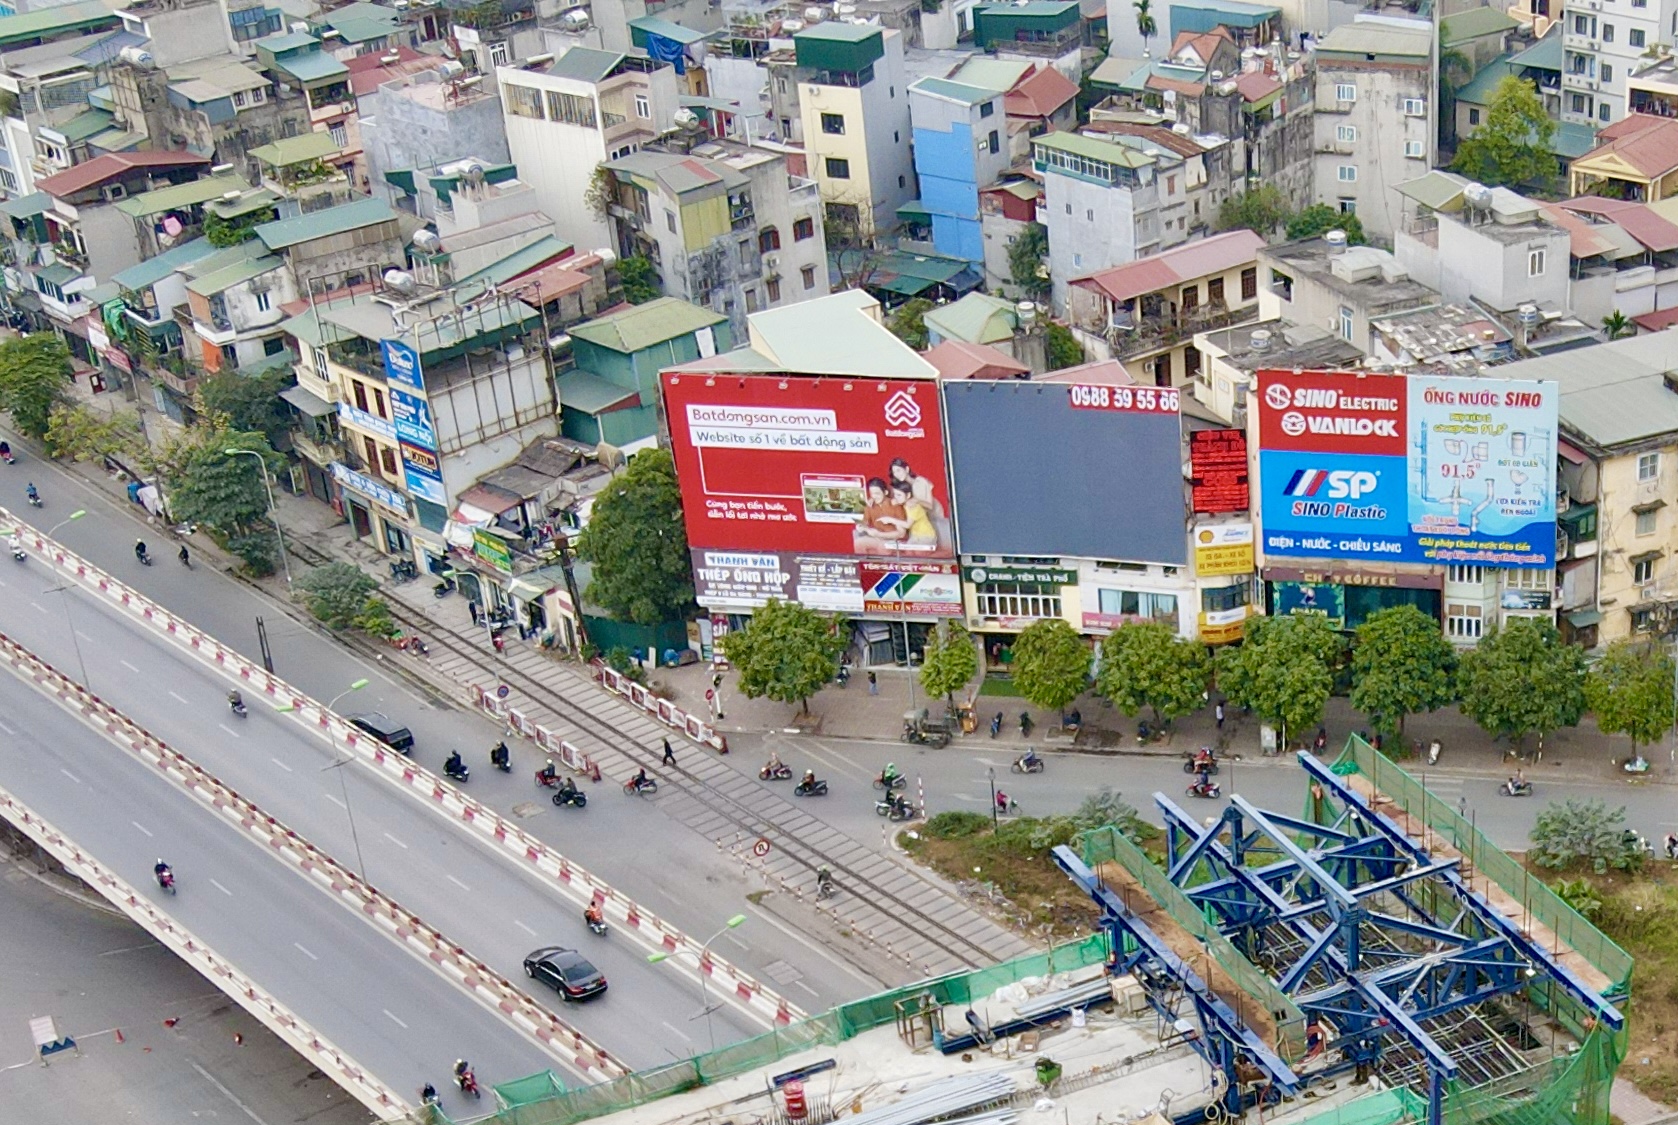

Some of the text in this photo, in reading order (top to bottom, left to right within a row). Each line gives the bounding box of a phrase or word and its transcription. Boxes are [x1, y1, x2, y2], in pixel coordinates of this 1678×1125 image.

[1071, 386, 1110, 407] 0988
[1113, 387, 1133, 409] 59
[1136, 389, 1156, 410] 55
[1293, 388, 1399, 412] SINO ELECTRIC
[1424, 386, 1542, 408] ỐNG NƯỚC SINO
[692, 408, 831, 427] Batdongsan.com.vn
[1306, 416, 1400, 438] VANLOCK
[696, 431, 872, 450] Website số 1 về bất động sản
[1328, 470, 1378, 499] SP
[1292, 501, 1387, 520] SINO Plastic
[1268, 535, 1294, 550] ĐIỆN
[1302, 536, 1332, 550] NƯỚC
[1339, 537, 1371, 552] CHIẾU
[1372, 540, 1402, 554] SÁNG
[709, 556, 776, 567] THANH VÂN
[697, 568, 730, 582] THÉP
[764, 571, 791, 588] HỘP
[1344, 573, 1397, 586] COFFEE
[895, 604, 912, 612] VN
